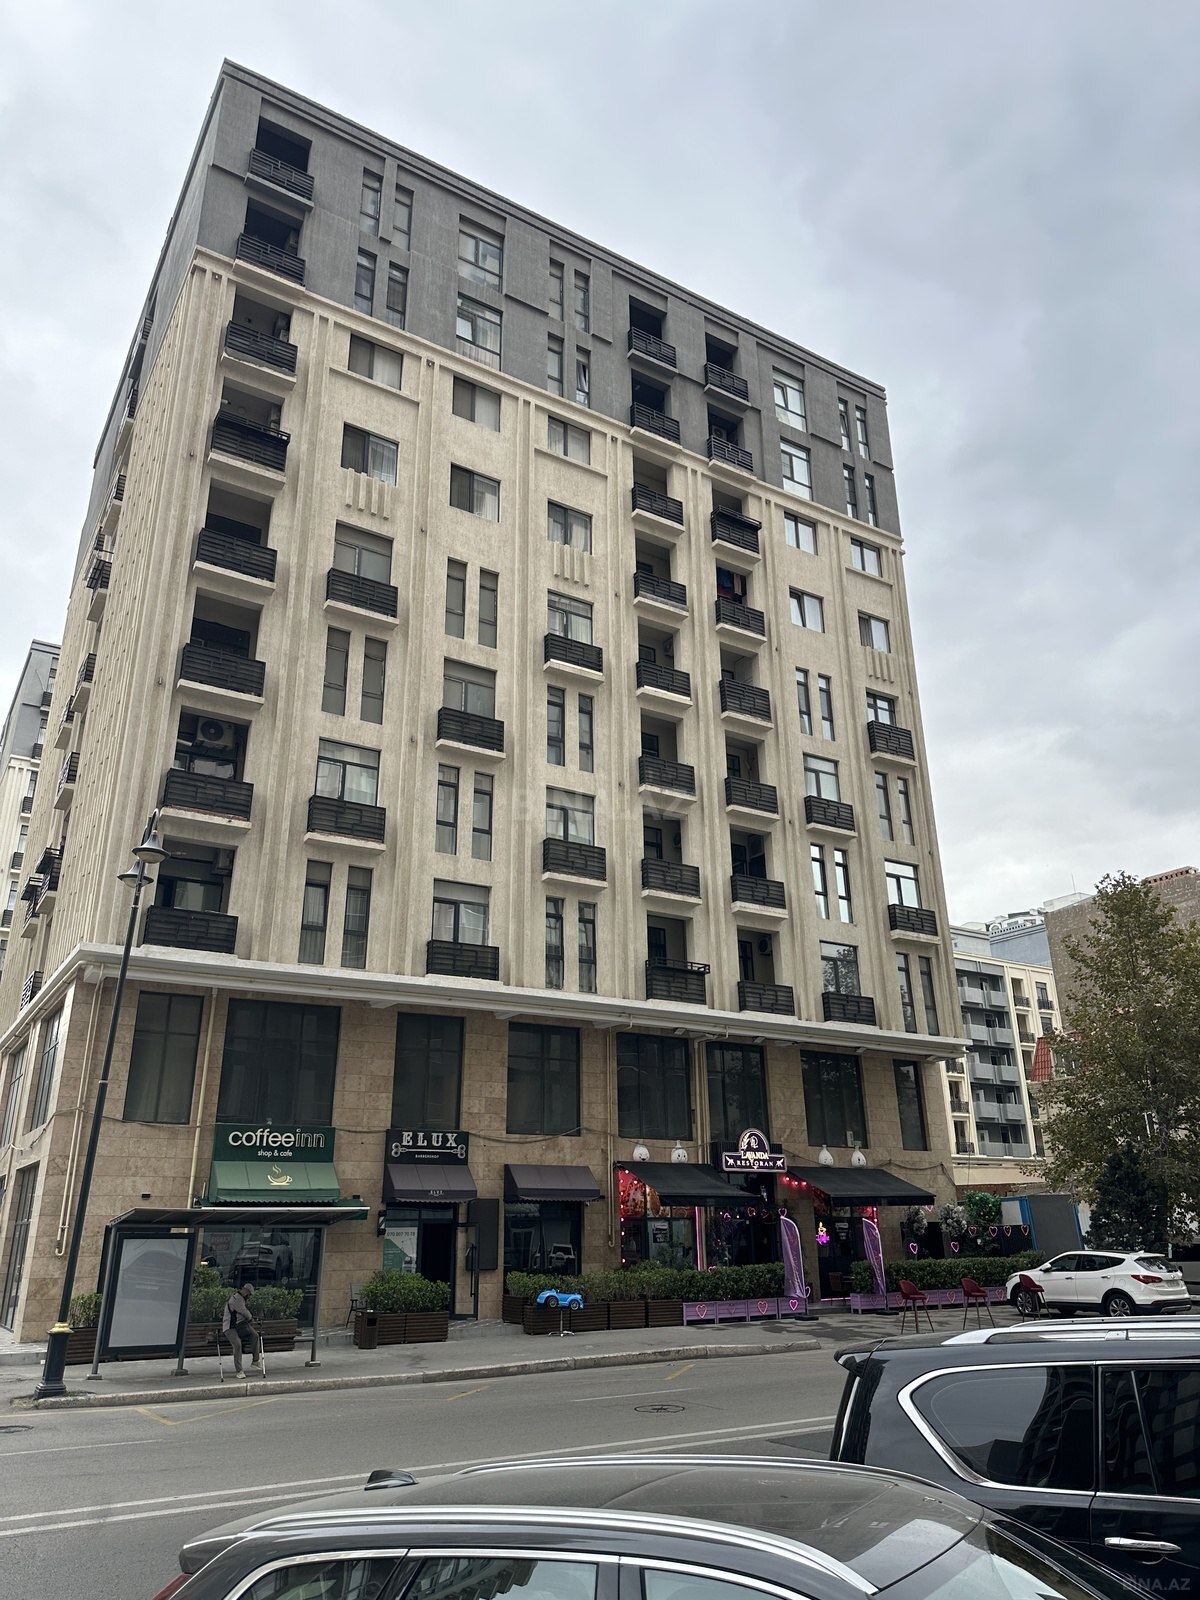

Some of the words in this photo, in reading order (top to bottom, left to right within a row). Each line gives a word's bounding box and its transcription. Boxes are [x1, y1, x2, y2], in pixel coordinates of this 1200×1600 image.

[401, 1131, 458, 1147] ELUX
[257, 1149, 272, 1157] shop
[273, 1149, 279, 1157] &
[280, 1149, 293, 1157] cafe
